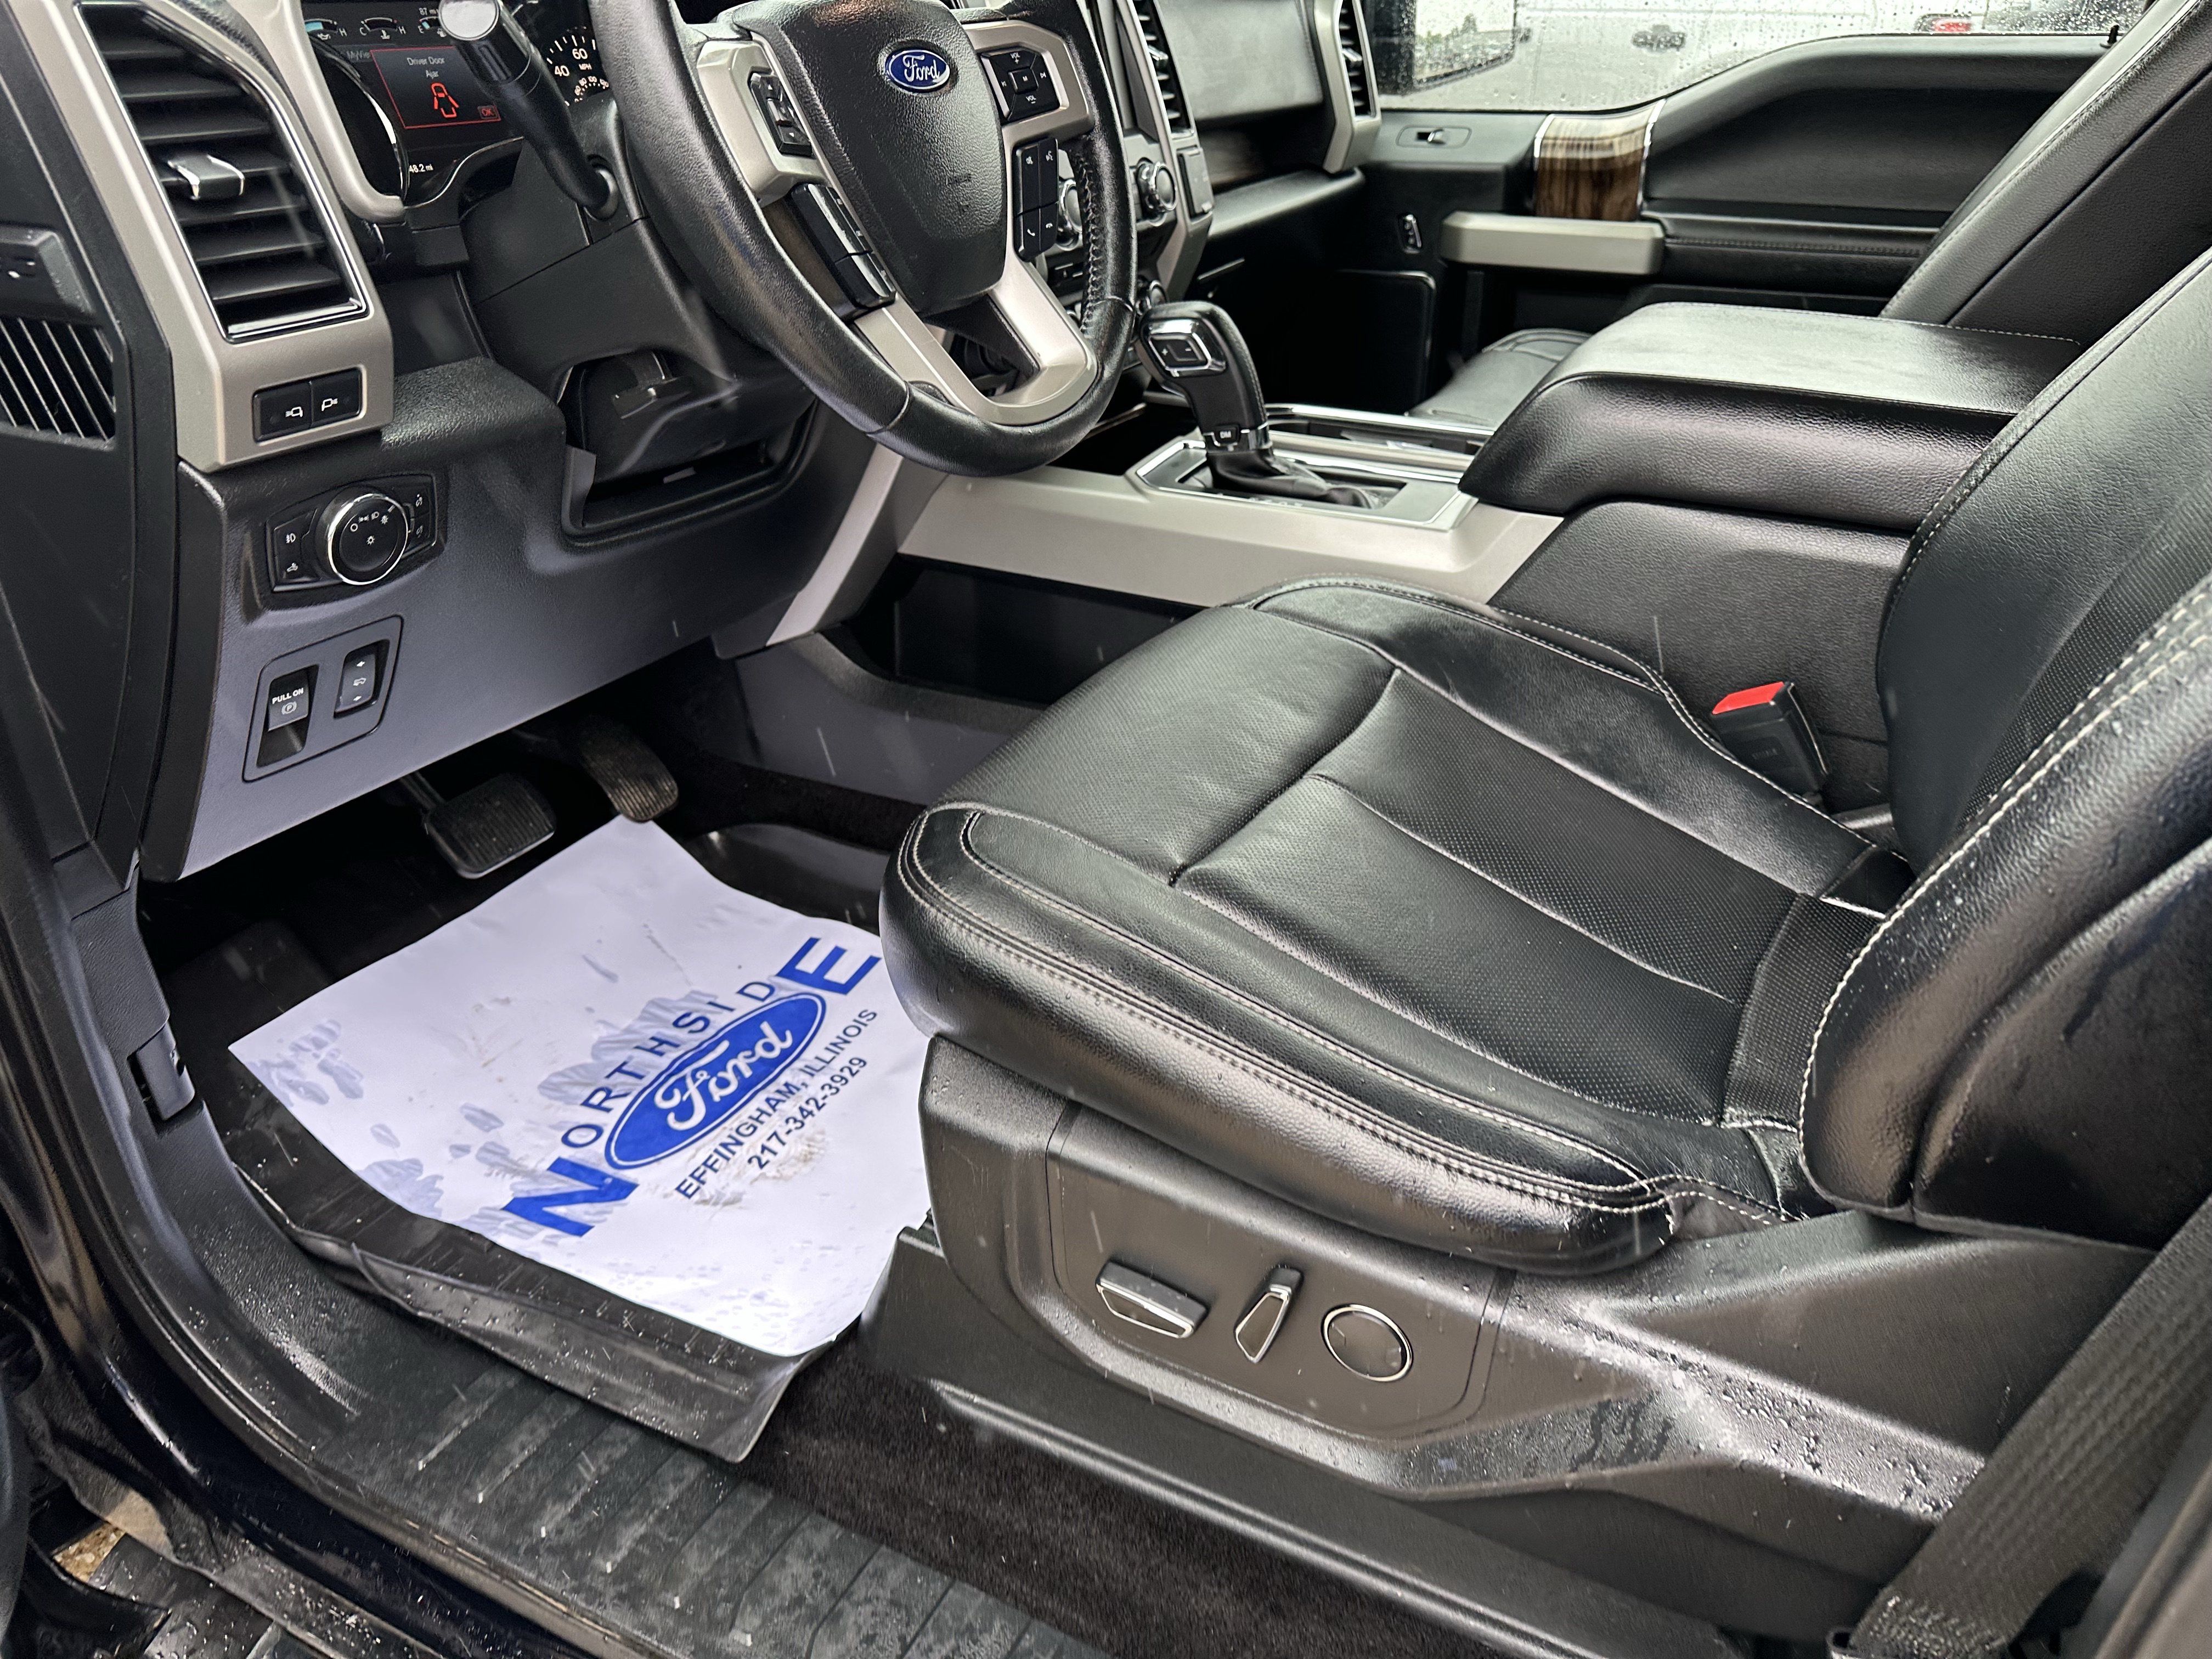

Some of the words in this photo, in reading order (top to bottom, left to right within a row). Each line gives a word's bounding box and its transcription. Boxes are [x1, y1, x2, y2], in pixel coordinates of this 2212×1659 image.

[407, 57, 427, 65] Driver
[428, 56, 445, 65] Door
[572, 48, 588, 60] 60
[902, 54, 941, 82] Ford
[554, 65, 570, 76] 40
[272, 692, 292, 704] PULL
[292, 687, 304, 696] ON
[504, 936, 882, 1238] NORTHSIDE
[654, 1020, 793, 1131] Ford
[675, 1079, 809, 1199] EFFINGHAM,
[800, 1008, 878, 1083] ILLINOIS
[748, 1057, 867, 1171] 217-342-3929
